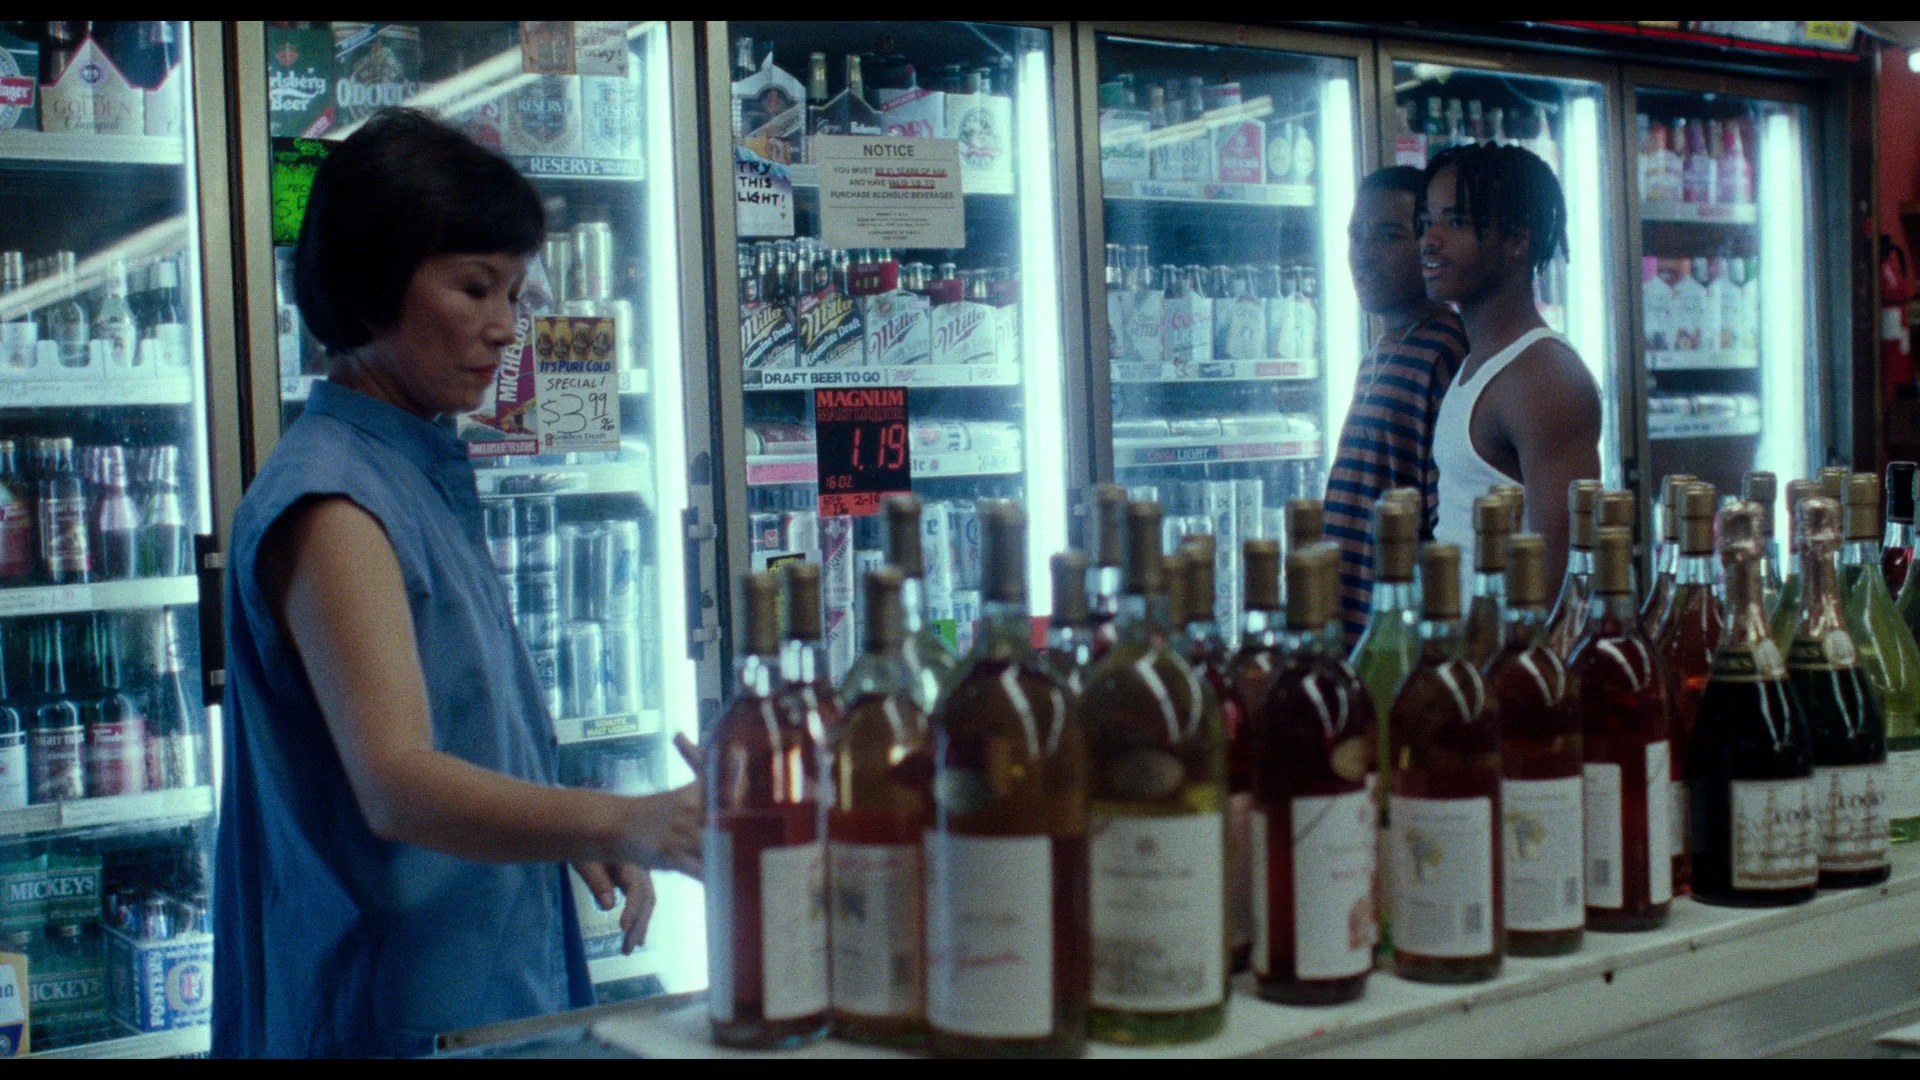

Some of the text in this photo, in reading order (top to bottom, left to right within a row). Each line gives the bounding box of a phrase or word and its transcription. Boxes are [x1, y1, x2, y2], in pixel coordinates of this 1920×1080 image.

[863, 144, 915, 157] NOTICE
[530, 157, 600, 173] RESERVE
[736, 160, 771, 175] TRY
[738, 176, 772, 188] THIS
[738, 191, 786, 209] LIGHT!
[830, 191, 870, 200] PURCHASE
[911, 191, 954, 200] BEVERAGES
[801, 296, 854, 348] Miller
[867, 310, 921, 360] Miller
[935, 311, 987, 355] Miller
[559, 360, 585, 373] PURE
[586, 360, 612, 373] COLD
[764, 366, 880, 383] DRAFT BEER TO GO
[816, 389, 904, 408] MAGNUM
[851, 423, 907, 471] 1.19
[1177, 446, 1210, 461] LIGHT
